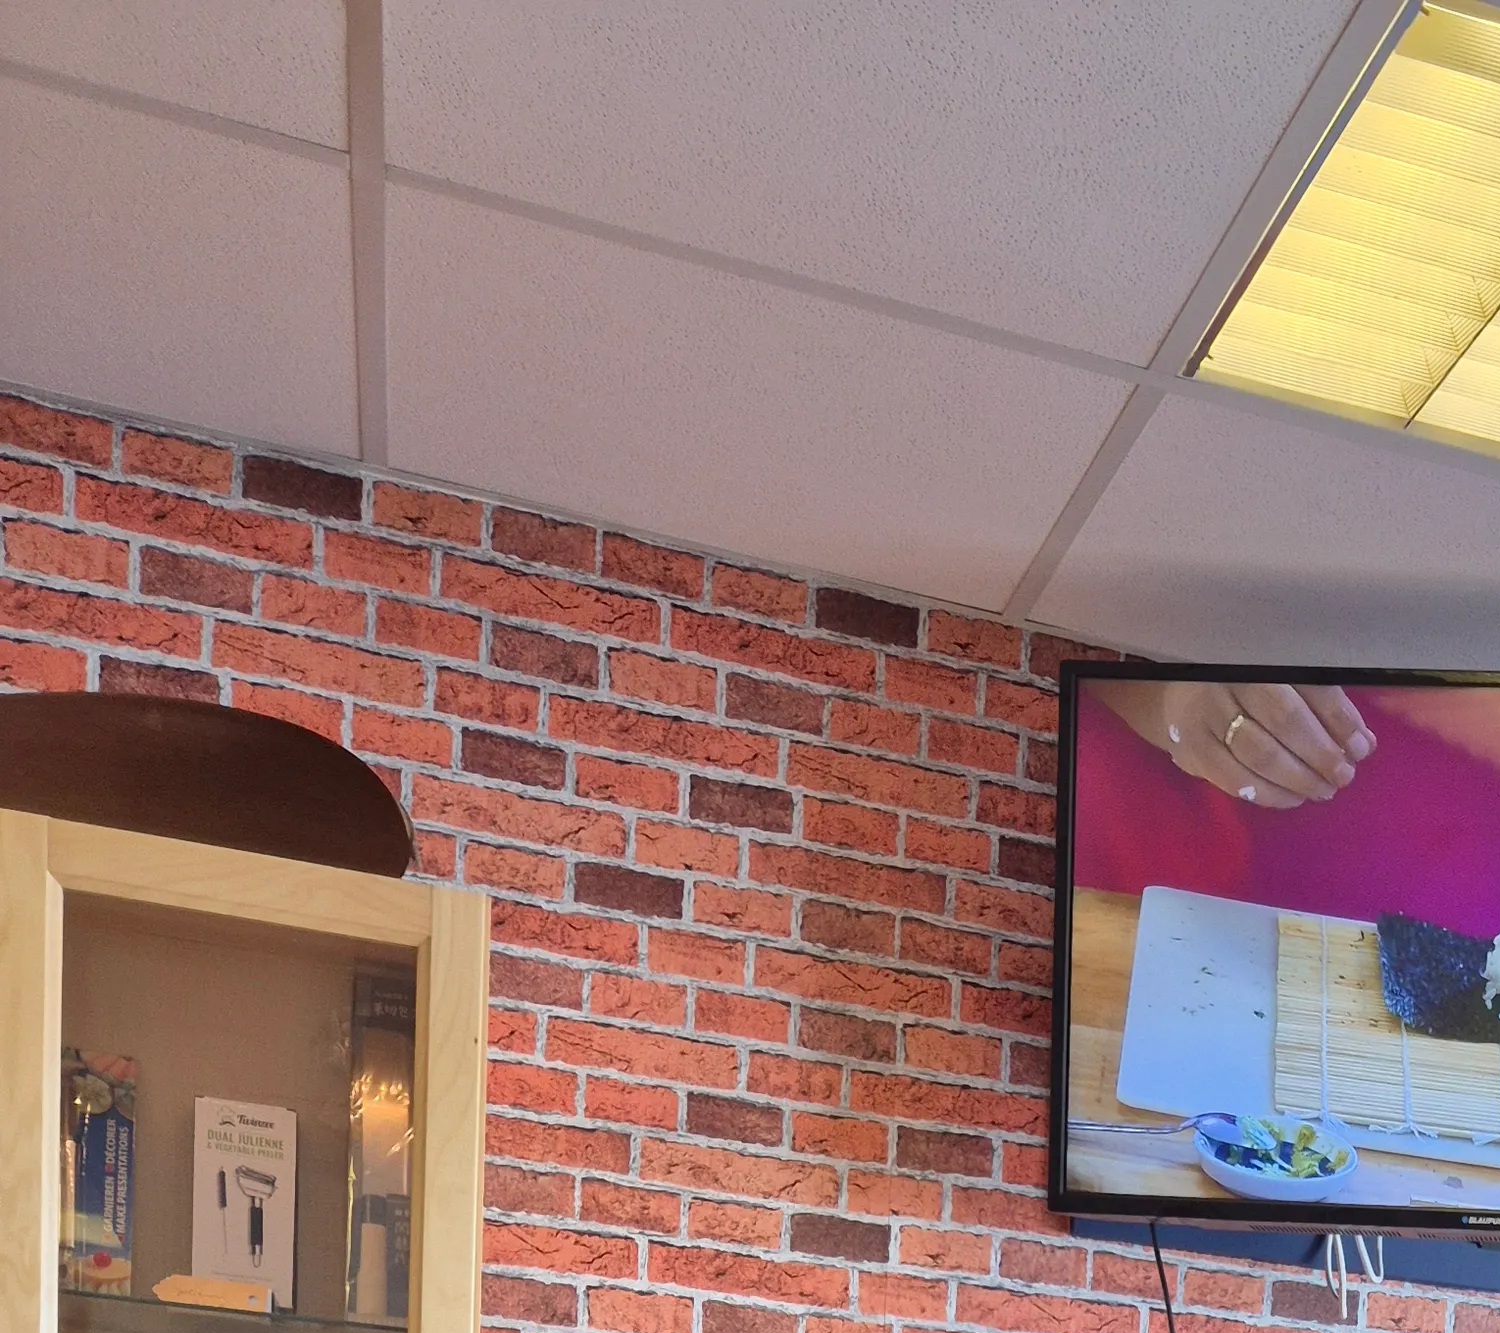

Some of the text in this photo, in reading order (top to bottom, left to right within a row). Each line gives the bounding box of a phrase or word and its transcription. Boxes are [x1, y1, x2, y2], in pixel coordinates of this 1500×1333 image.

[104, 1119, 116, 1164] DÉCORER
[207, 1129, 285, 1151] DUAL JULIENNE
[215, 1143, 256, 1156] VEGETABLE
[116, 1126, 129, 1233] MAKE PRESENTATIONS
[103, 1176, 114, 1232] GARNIEREN
